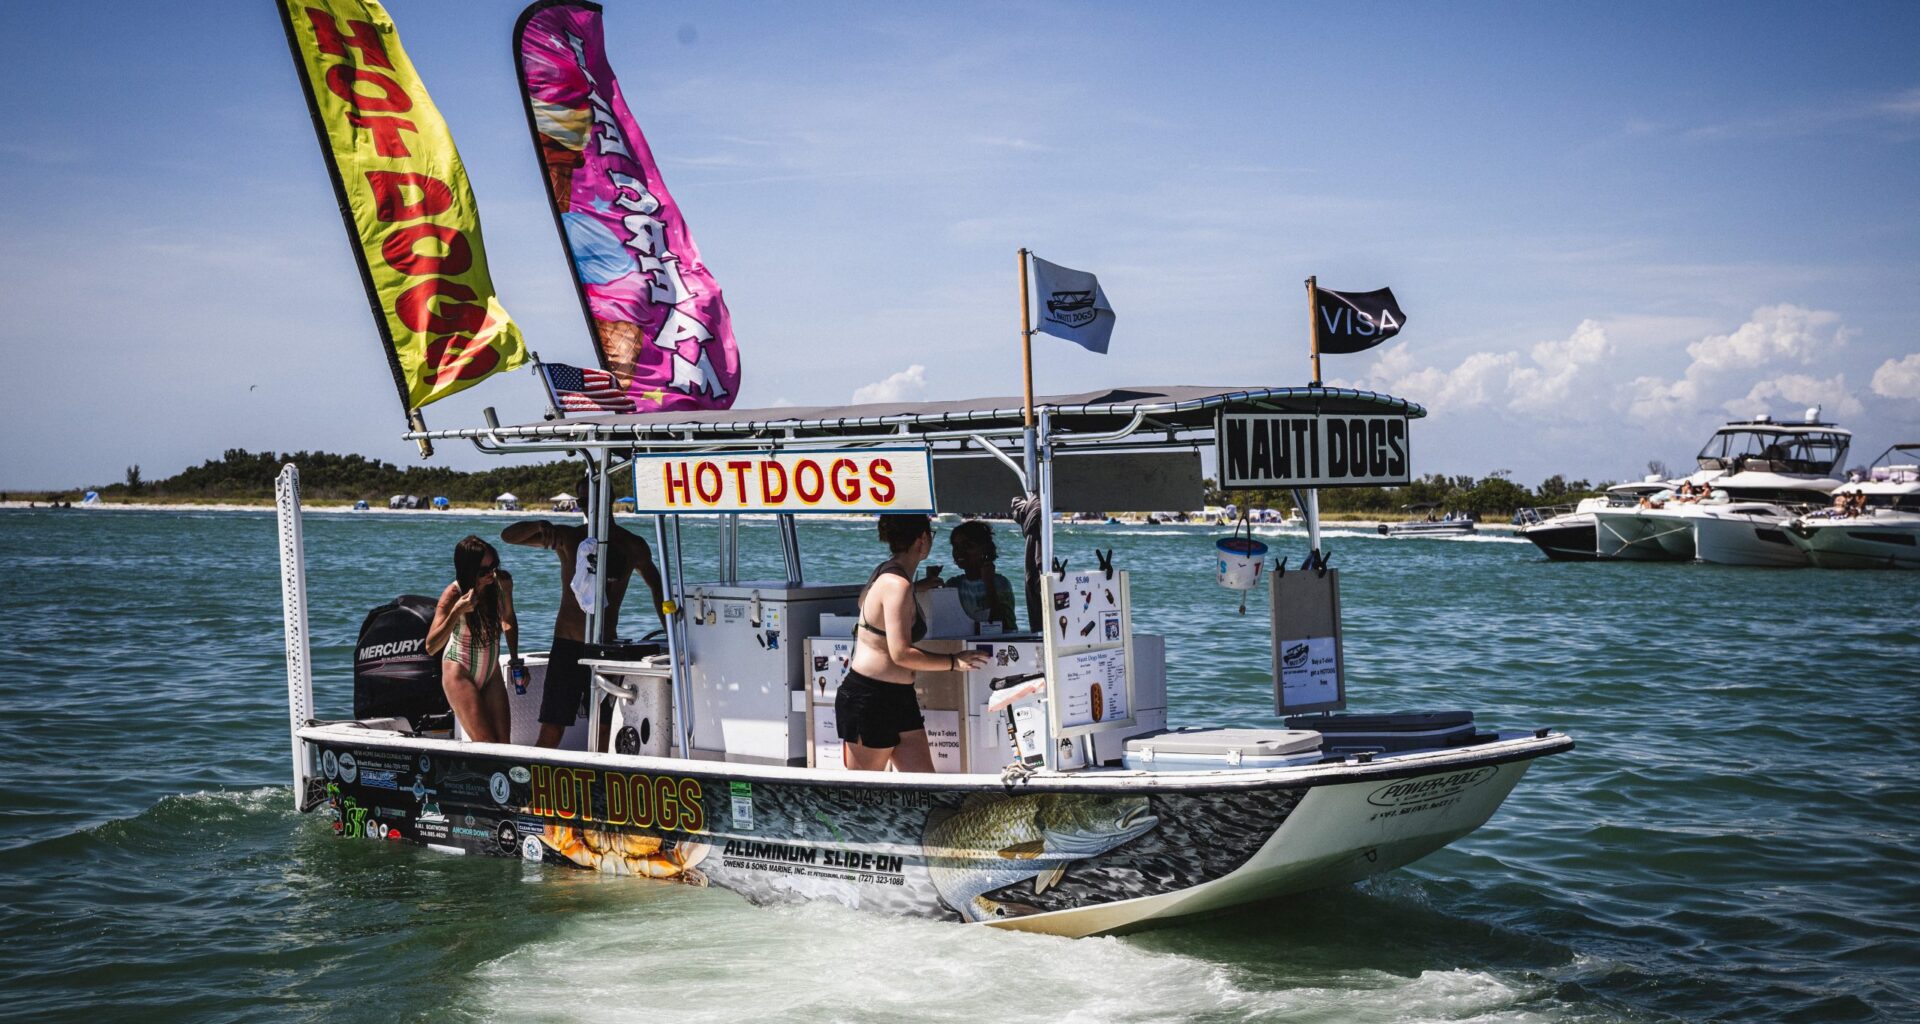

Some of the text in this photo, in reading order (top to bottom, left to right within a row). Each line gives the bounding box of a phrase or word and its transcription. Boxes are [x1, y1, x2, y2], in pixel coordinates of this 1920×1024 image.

[1056, 310, 1093, 323] NAUTI DOGS
[1321, 305, 1401, 336] VISA
[1226, 418, 1406, 480] NAUTI DOGS
[663, 457, 896, 507] HOTDOGS
[1075, 576, 1090, 584] $5.00
[359, 638, 425, 661] MERCURY
[531, 764, 596, 822] HOT
[605, 772, 704, 833] DOGS
[1380, 770, 1483, 799] POWER-POLE
[723, 840, 904, 873] ALUMINUM SLIDE-ON
[723, 859, 744, 869] OWENS
[745, 861, 750, 869] &
[751, 862, 767, 871] SONS
[768, 864, 793, 875] MARINE,
[794, 867, 806, 875] INC.
[858, 874, 874, 884] (727)
